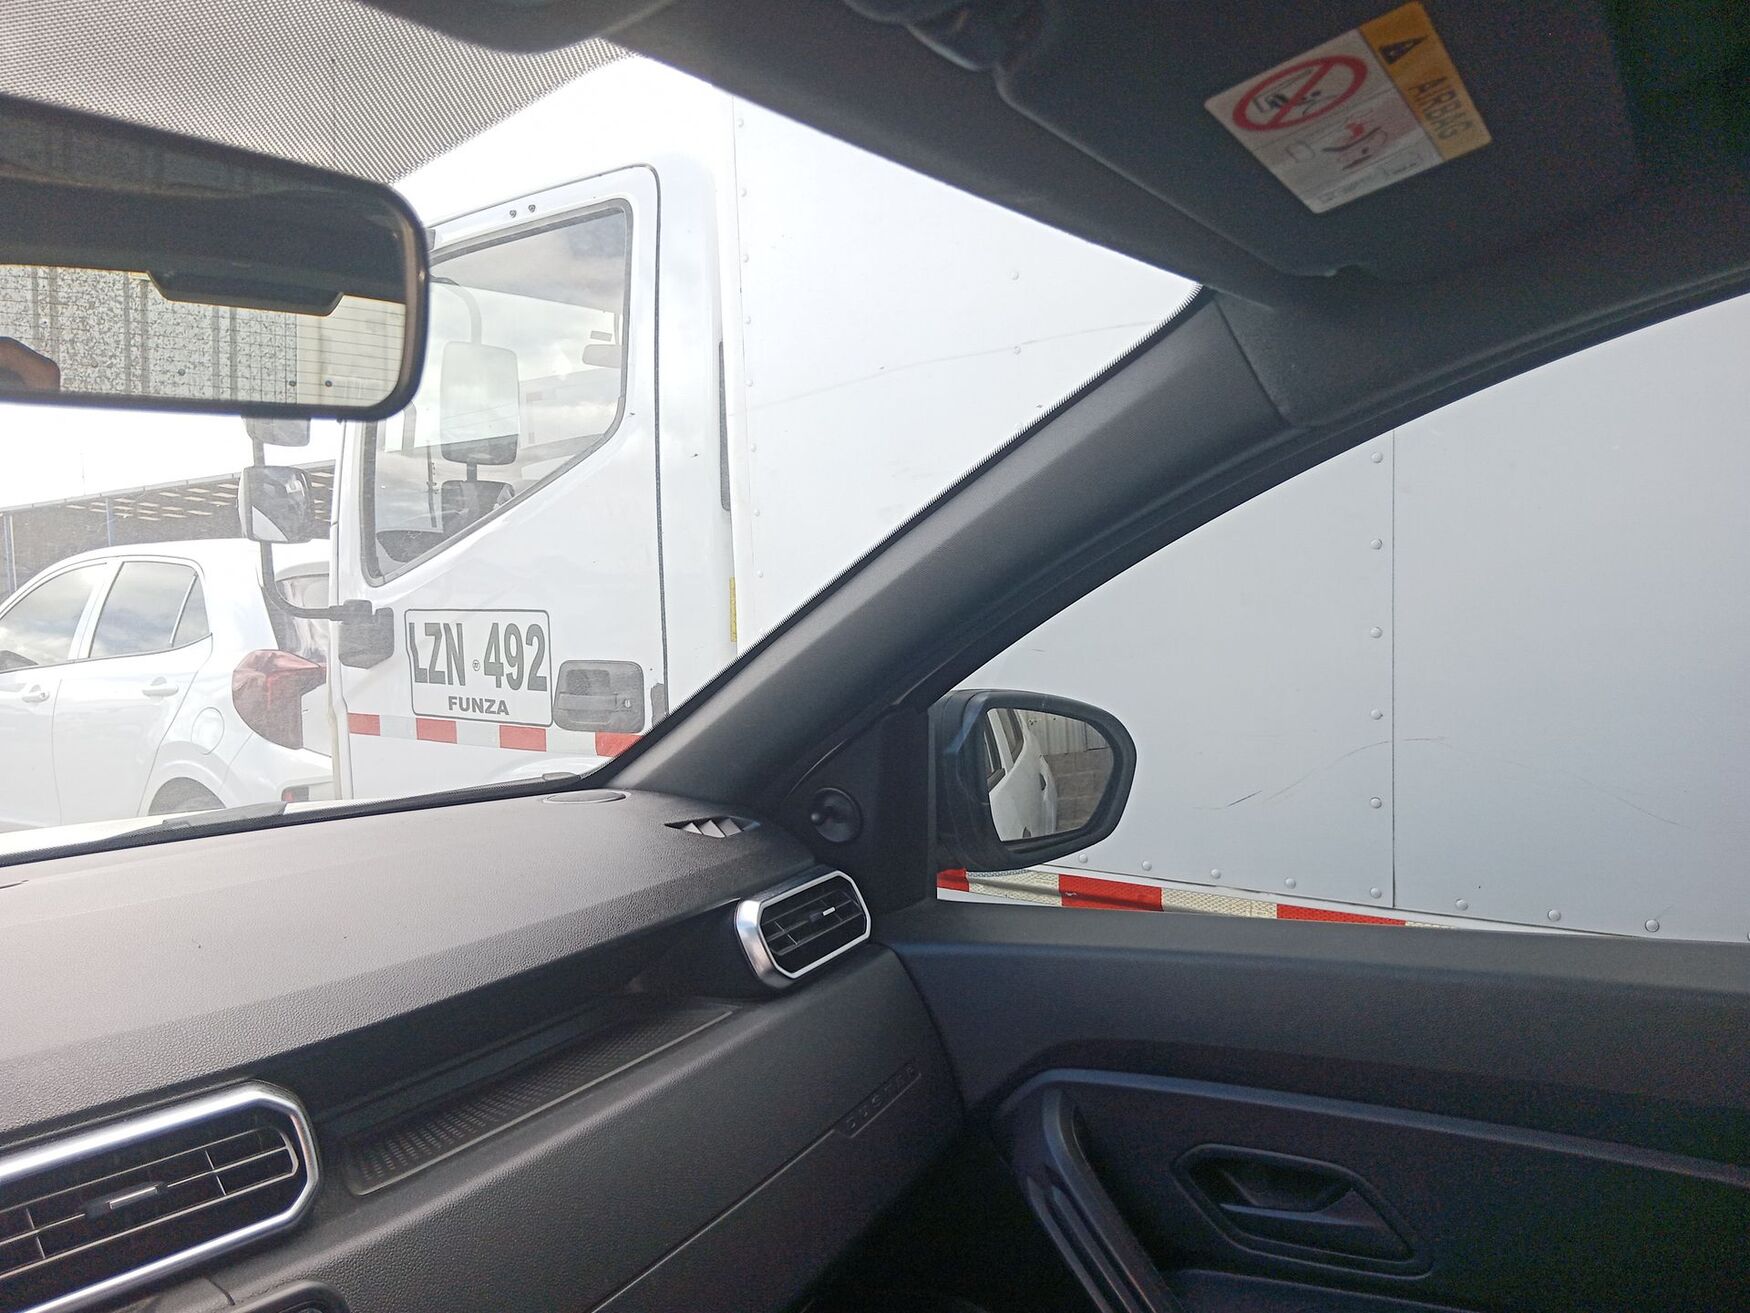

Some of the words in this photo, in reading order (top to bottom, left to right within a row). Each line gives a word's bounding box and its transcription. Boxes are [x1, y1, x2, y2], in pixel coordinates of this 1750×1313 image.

[1408, 76, 1473, 140] AIRBAG
[409, 622, 466, 686] LZN
[483, 622, 548, 692] 492
[448, 695, 510, 716] FUNZA
